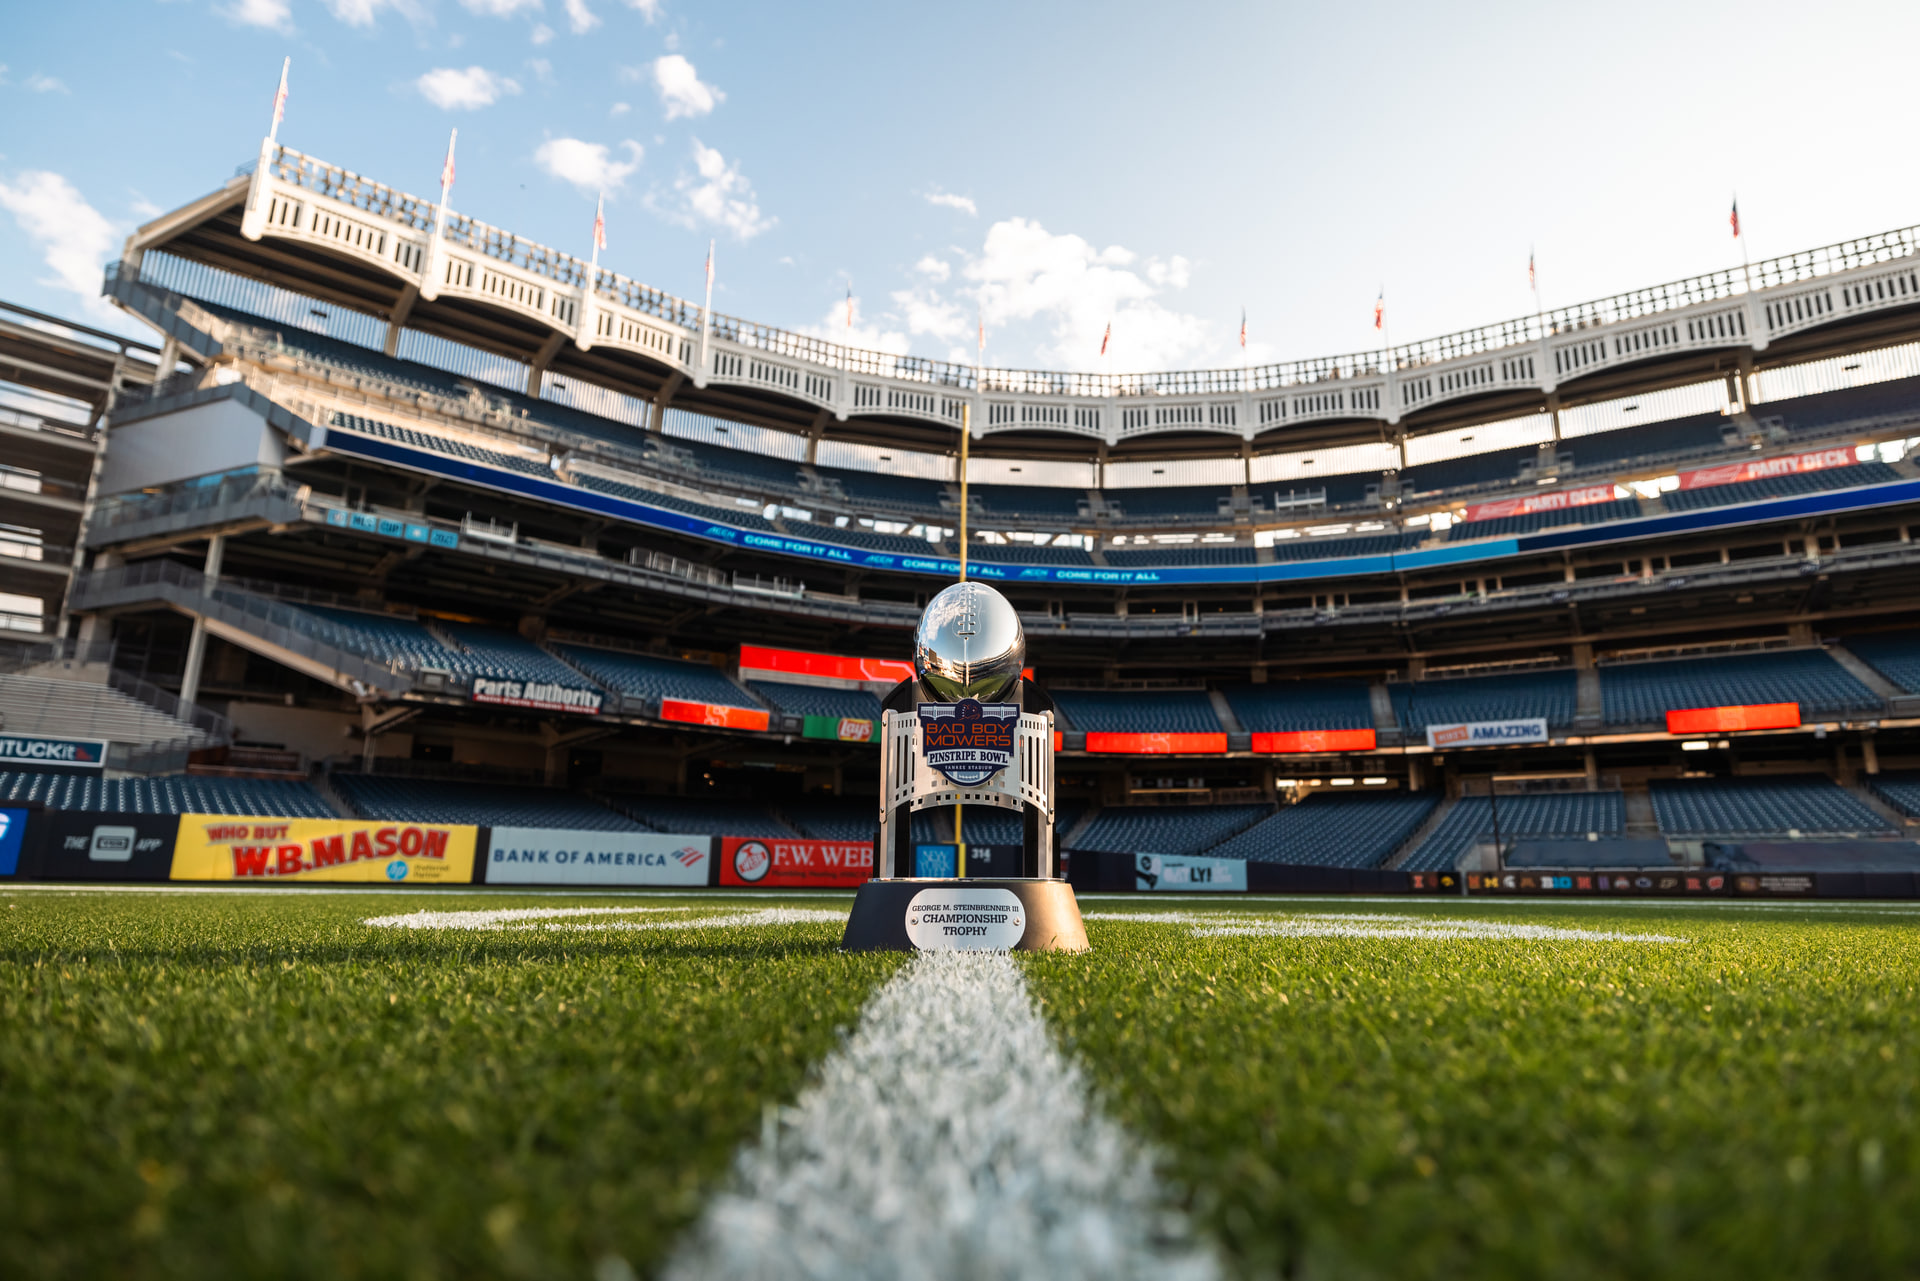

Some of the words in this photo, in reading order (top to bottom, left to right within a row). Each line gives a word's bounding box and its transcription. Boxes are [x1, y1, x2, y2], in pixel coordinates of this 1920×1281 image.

[1747, 457, 1799, 478] PARTY
[1801, 448, 1849, 469] DECK
[1523, 490, 1567, 512] PARTY
[1569, 485, 1609, 504] DECK
[744, 534, 783, 548] COME
[785, 541, 812, 554] FOR
[813, 545, 826, 556] IT
[827, 548, 852, 560] ALL
[902, 558, 938, 570] COME
[966, 565, 979, 574] IT
[981, 566, 1005, 577] ALL
[1056, 569, 1092, 580] COME
[1094, 571, 1119, 581] FOR
[1121, 572, 1133, 581] IT
[1135, 571, 1160, 581] ALL
[473, 679, 523, 699] Parts
[523, 682, 603, 708] Authority
[926, 723, 965, 734] BAD
[972, 723, 1010, 734] BOY
[1472, 724, 1542, 740] AMAZING
[926, 735, 1011, 746] MOWERS
[929, 750, 977, 764] PINSTRIPE
[980, 750, 1008, 764] BOWL
[206, 825, 249, 842] WHO
[252, 824, 289, 840] BUT
[64, 836, 89, 850] THE
[136, 838, 163, 851] APP
[493, 849, 549, 864] BANK
[555, 850, 579, 864] OF
[584, 851, 667, 867] AMERICA
[772, 843, 815, 867] F.W.
[911, 904, 942, 912] GEORGE
[952, 904, 1011, 912] STEINBRENNER
[922, 913, 1009, 924] CHAMPIONSHIP
[943, 926, 988, 936] TROPHY
